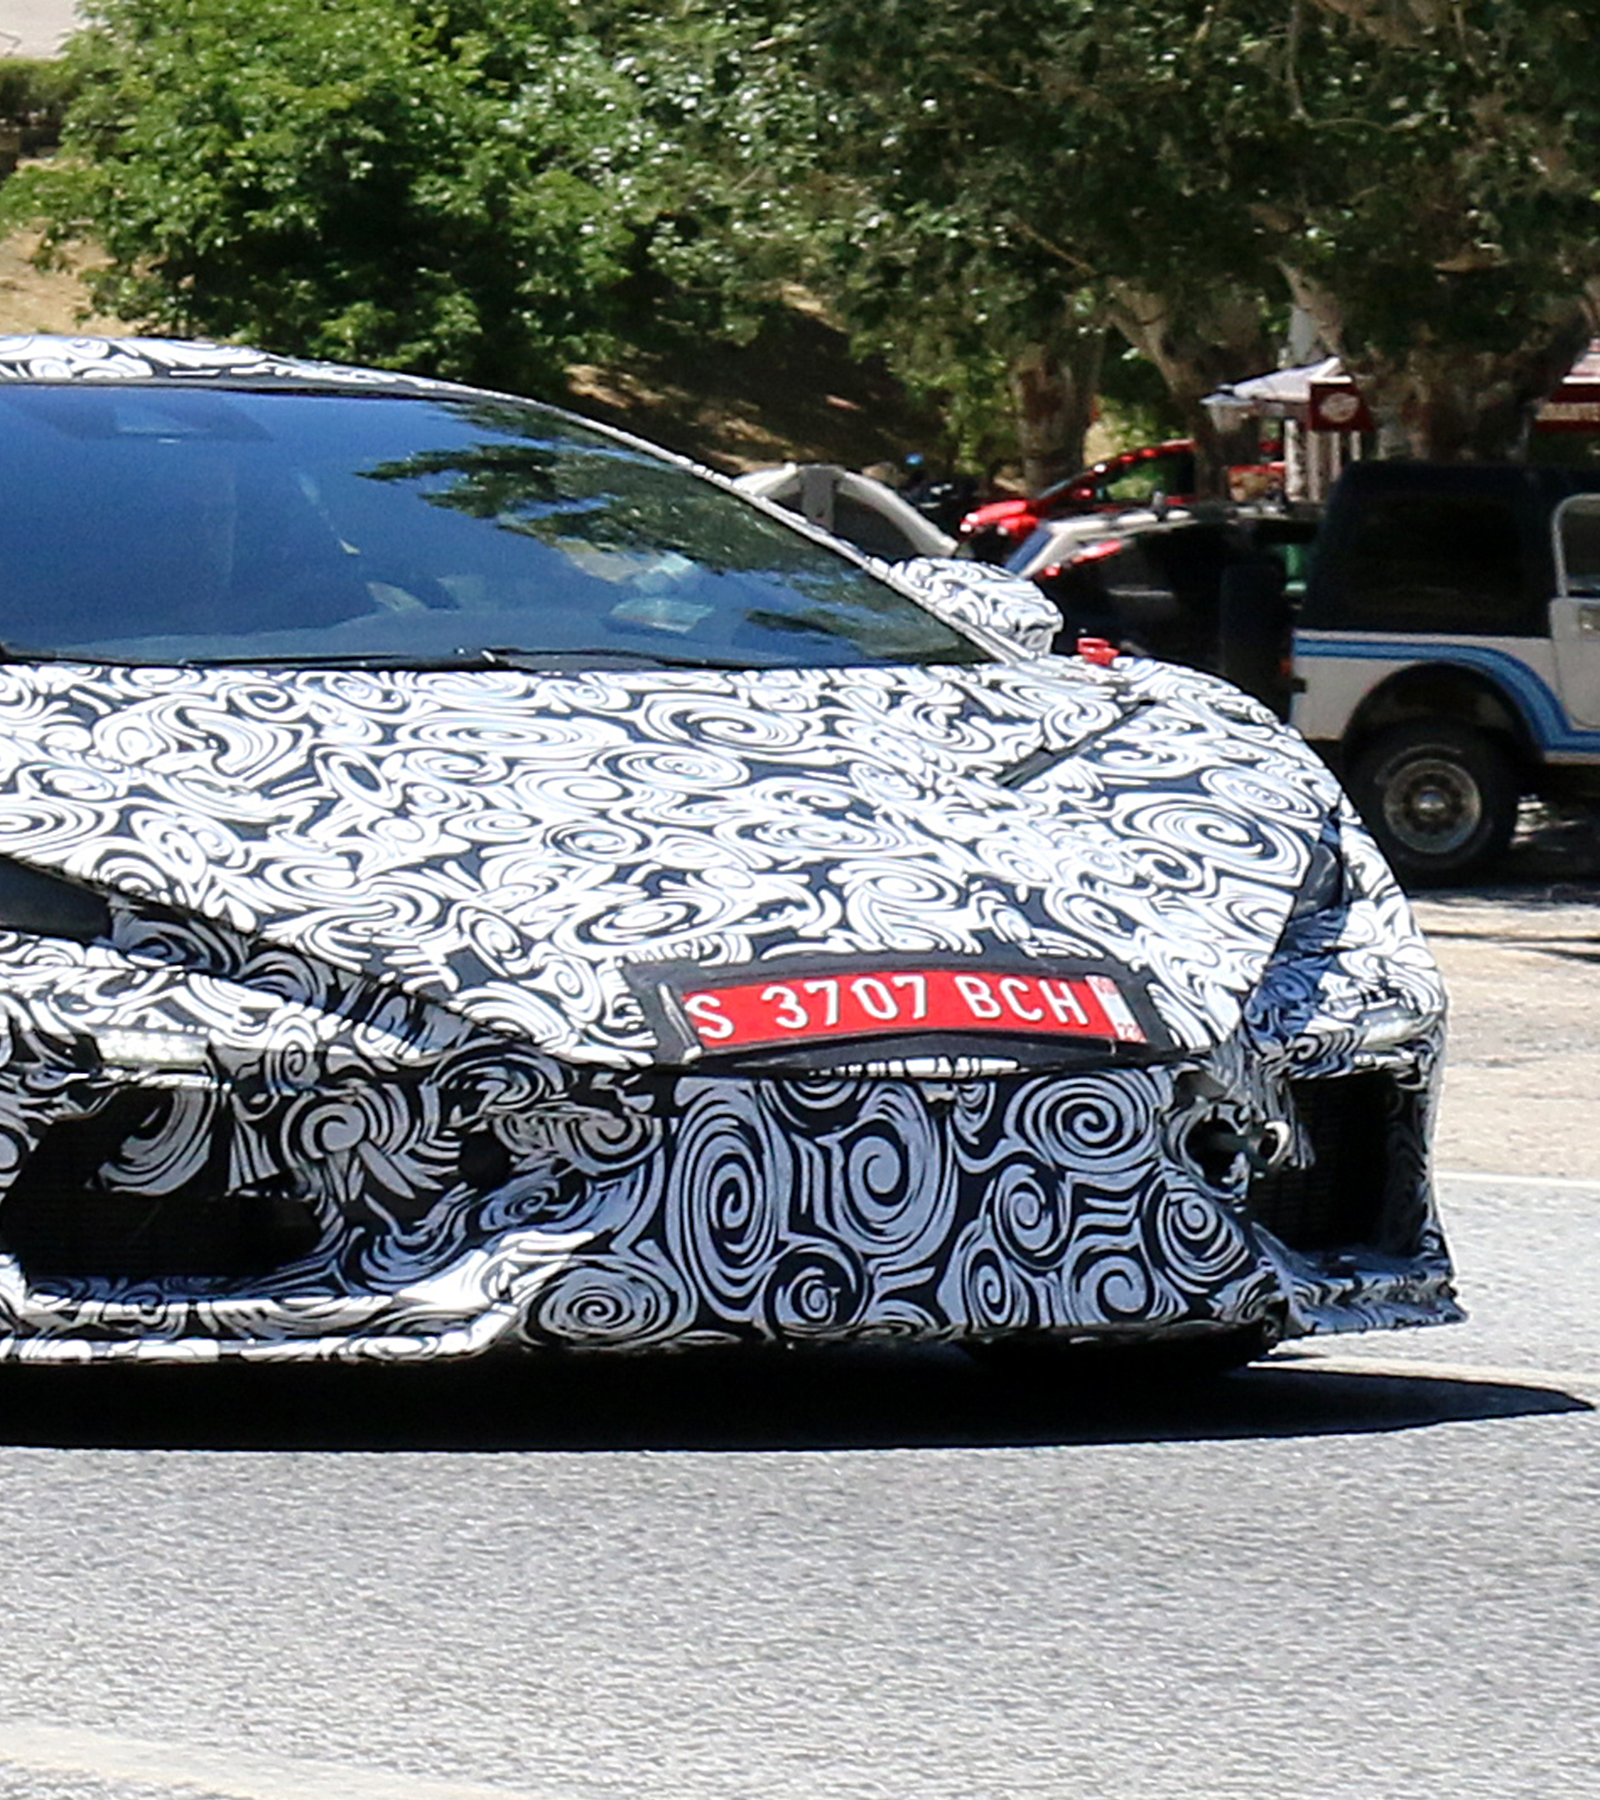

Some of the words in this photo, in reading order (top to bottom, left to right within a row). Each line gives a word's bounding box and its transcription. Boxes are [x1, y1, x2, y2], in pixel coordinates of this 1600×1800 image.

[684, 994, 735, 1039] S
[761, 975, 927, 1029] 3707
[954, 975, 1090, 1025] BCH
